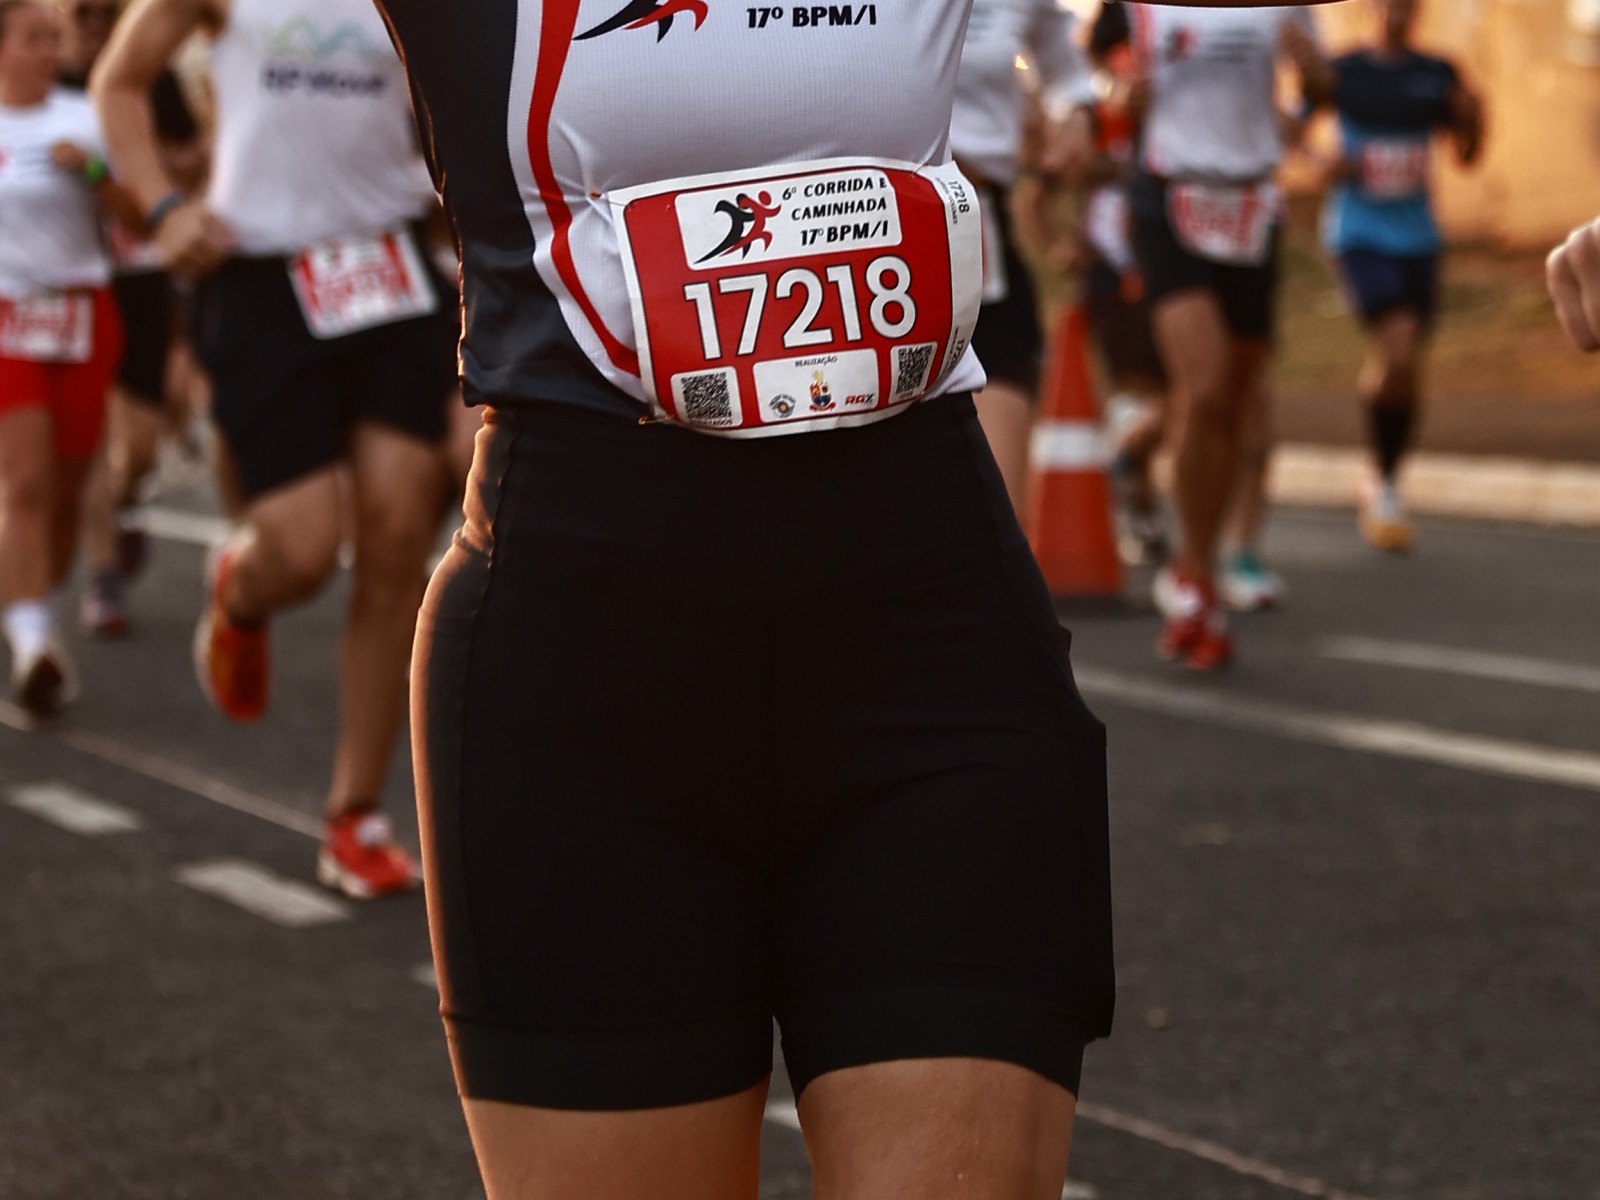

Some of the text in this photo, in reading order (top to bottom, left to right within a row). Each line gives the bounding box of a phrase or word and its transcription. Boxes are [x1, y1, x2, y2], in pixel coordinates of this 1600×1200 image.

[746, 4, 877, 29] 17º BPM/I
[803, 176, 874, 198] CORRIDA
[879, 177, 888, 189] E
[948, 181, 970, 213] 17218
[791, 196, 887, 221] CAMINHADA
[800, 220, 889, 247] 17º BPM/I
[683, 254, 917, 361] 17218
